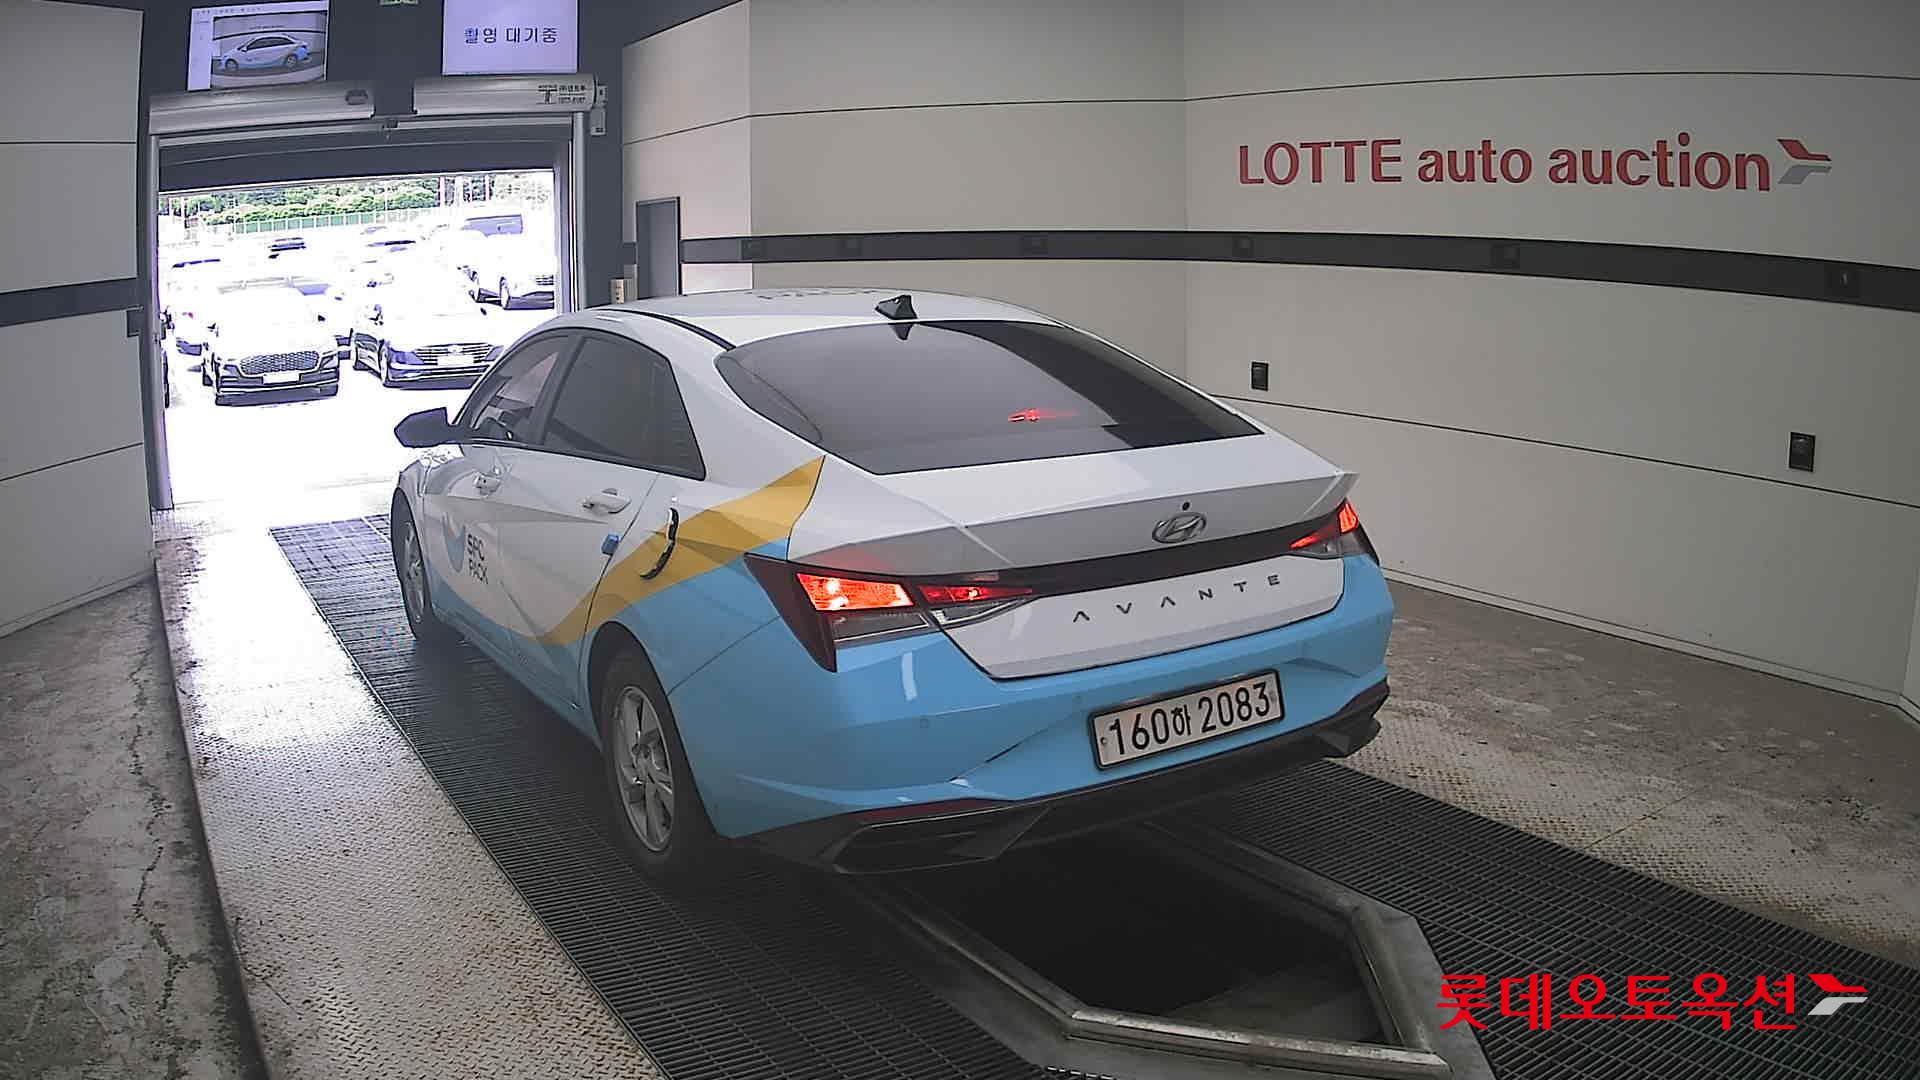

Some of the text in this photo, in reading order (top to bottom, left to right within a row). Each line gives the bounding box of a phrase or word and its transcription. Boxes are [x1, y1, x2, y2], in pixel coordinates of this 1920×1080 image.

[505, 27, 558, 43] 대기중
[1239, 132, 1771, 191] LOTTE auto auction
[467, 533, 485, 561] SPC
[468, 558, 489, 585] PACK
[1072, 574, 1281, 623] AVANTE
[1199, 680, 1271, 734] 2083
